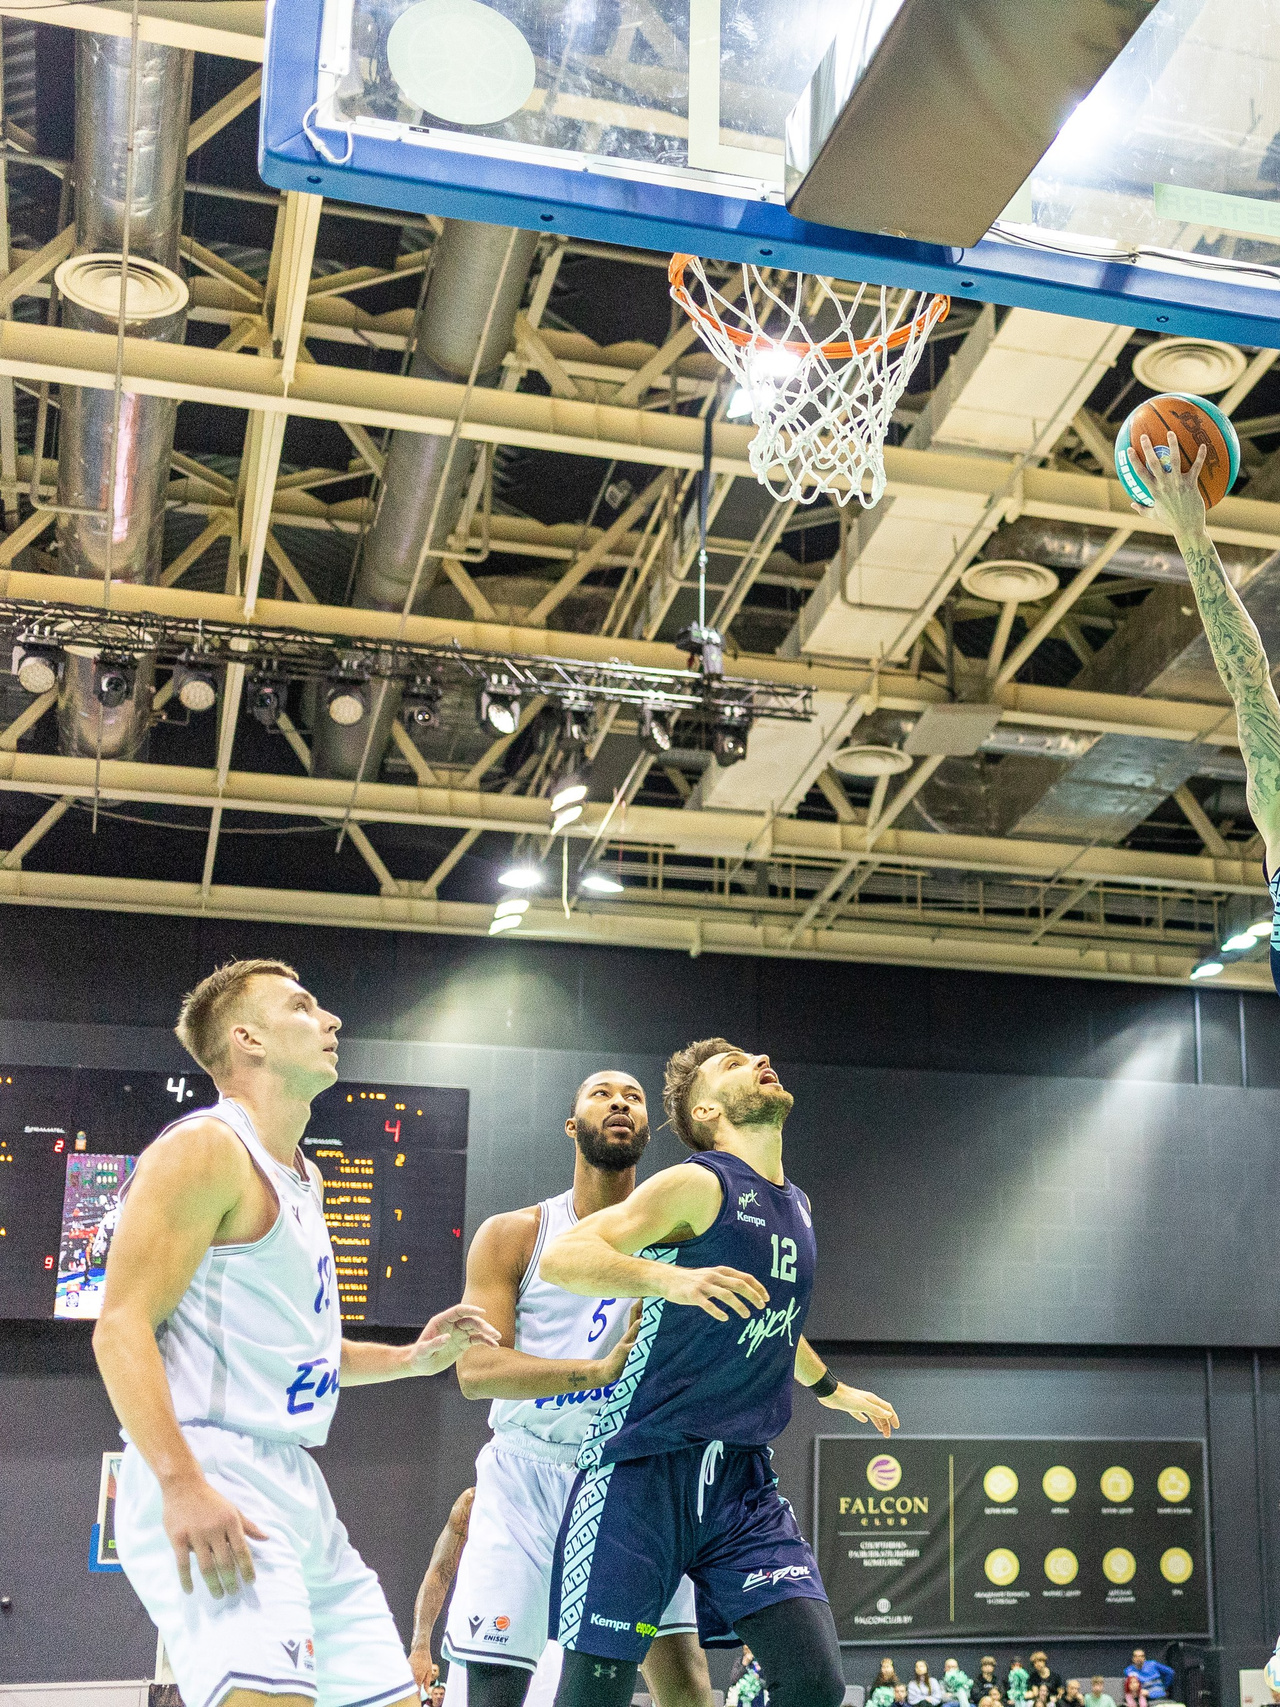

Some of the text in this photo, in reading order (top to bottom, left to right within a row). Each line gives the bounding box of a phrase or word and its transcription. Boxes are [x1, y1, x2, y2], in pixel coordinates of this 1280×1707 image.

[385, 1120, 401, 1142] 4
[54, 1139, 65, 1153] 2
[736, 1210, 766, 1228] Kempa
[770, 1233, 798, 1284] 12
[587, 1297, 617, 1343] 5
[839, 1496, 929, 1515] FALCON
[860, 1517, 908, 1527] CLUB
[590, 1612, 631, 1632] Kempa
[483, 1634, 509, 1644] ENISEY
